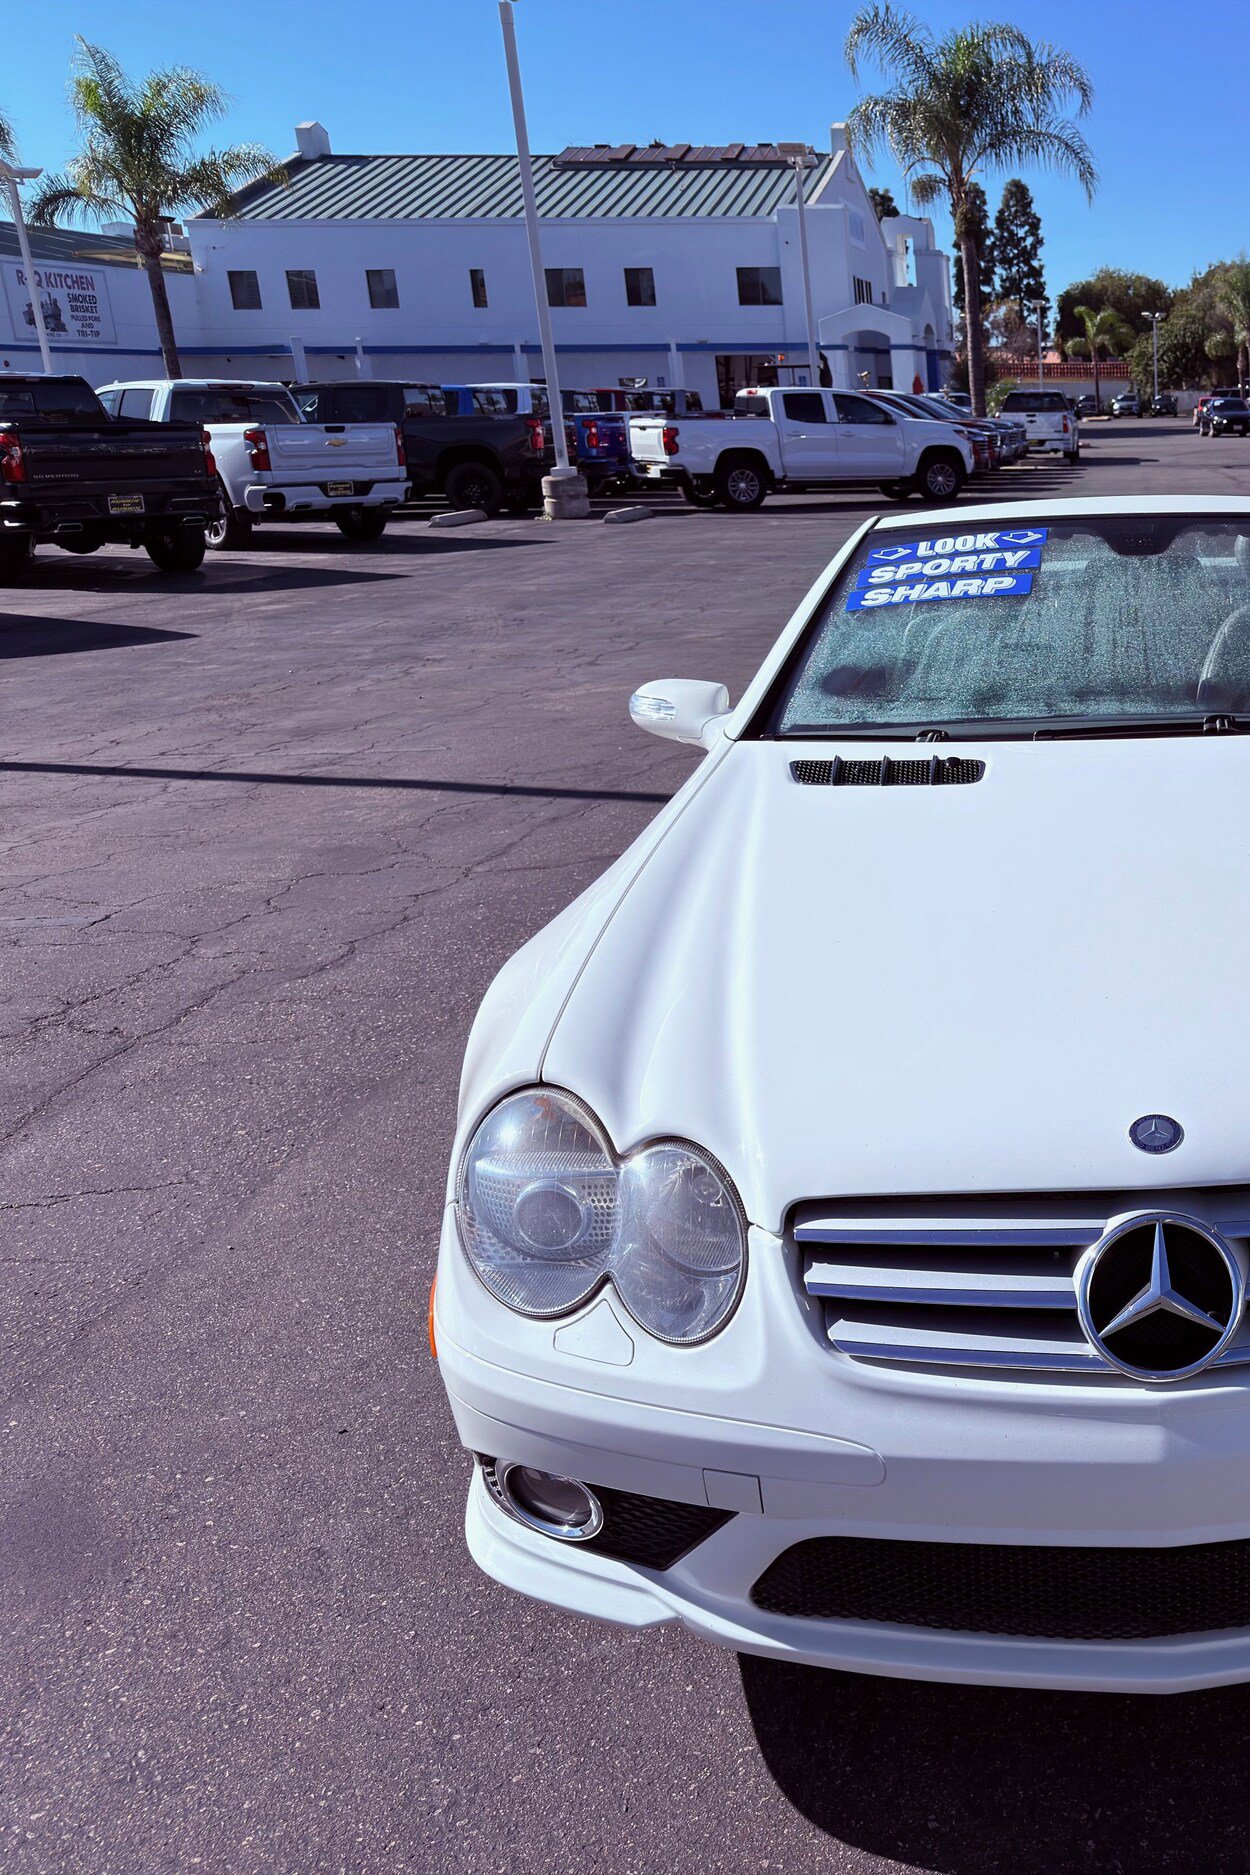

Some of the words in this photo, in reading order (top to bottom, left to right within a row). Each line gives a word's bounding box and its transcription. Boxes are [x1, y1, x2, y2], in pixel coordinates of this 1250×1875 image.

[44, 271, 95, 291] KITCHEN
[67, 293, 97, 305] SMOKED
[70, 304, 98, 314] BRISKET
[77, 329, 101, 338] TRI-TIP
[917, 532, 1000, 557] LOOK
[868, 550, 1031, 584] SPORTY
[861, 577, 1017, 607] SHARP
